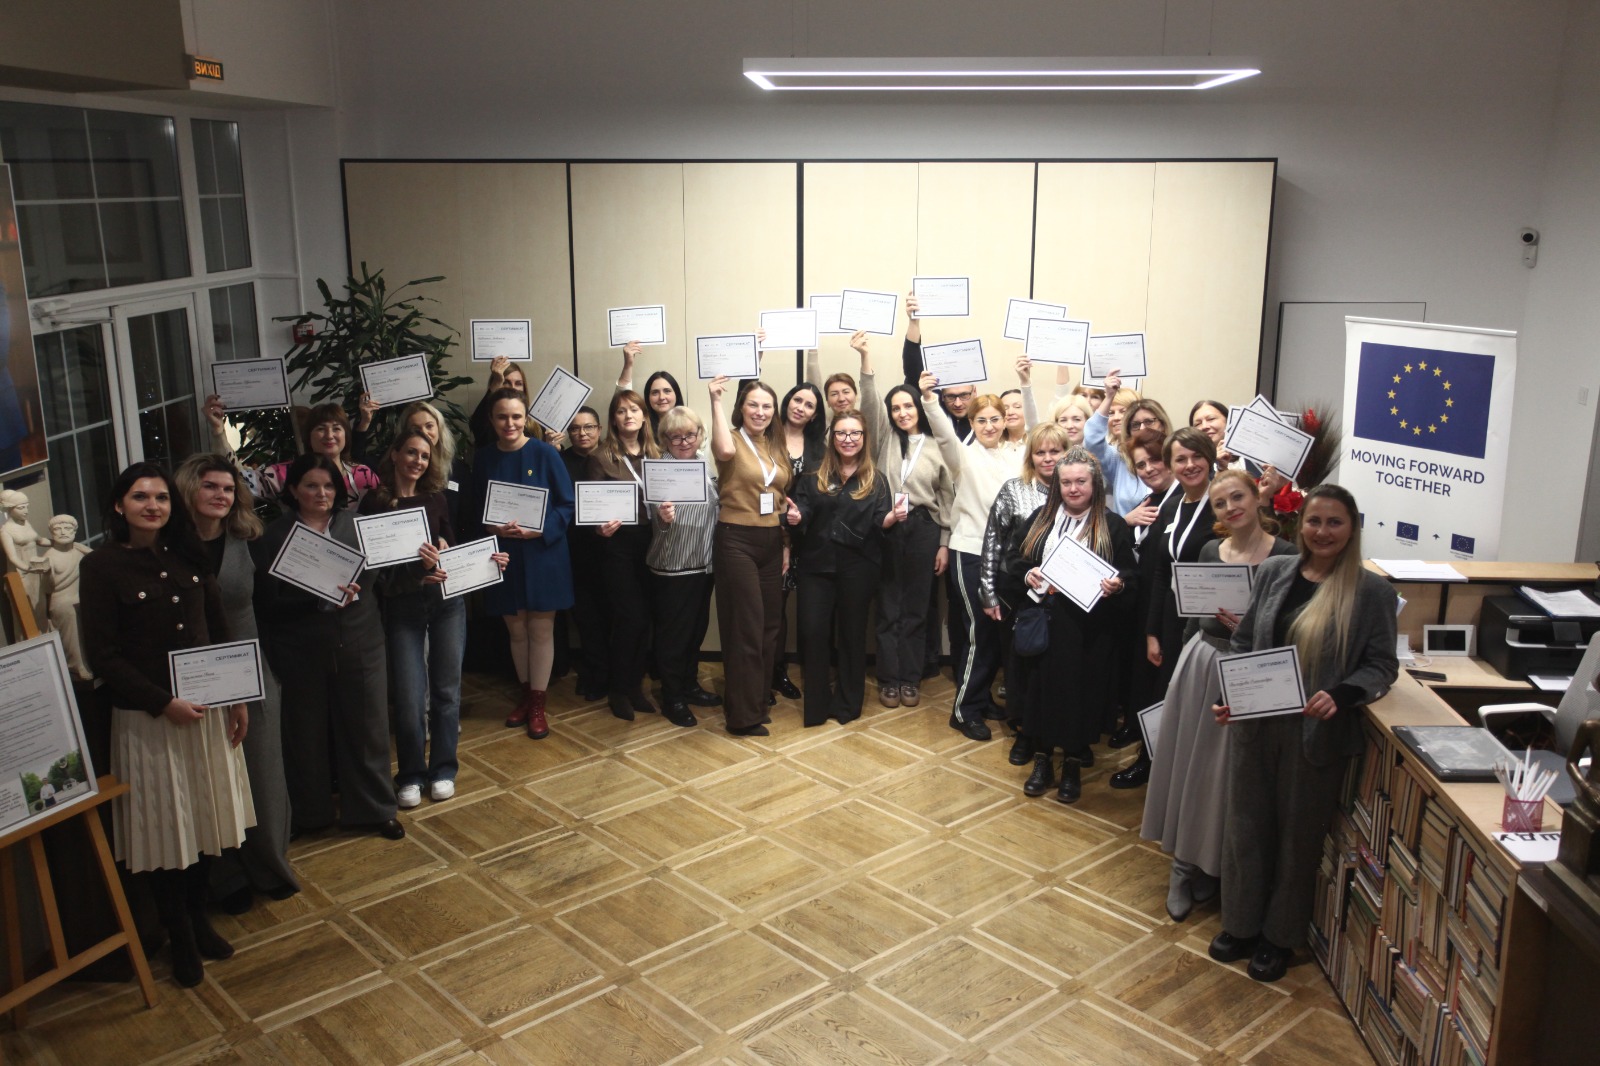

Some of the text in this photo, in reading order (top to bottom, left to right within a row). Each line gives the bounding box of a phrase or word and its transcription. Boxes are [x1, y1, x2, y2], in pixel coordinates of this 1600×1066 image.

[194, 62, 221, 78] ВИХІД
[1351, 449, 1485, 484] MOVING FORWARD
[1376, 471, 1451, 496] TOGETHER
